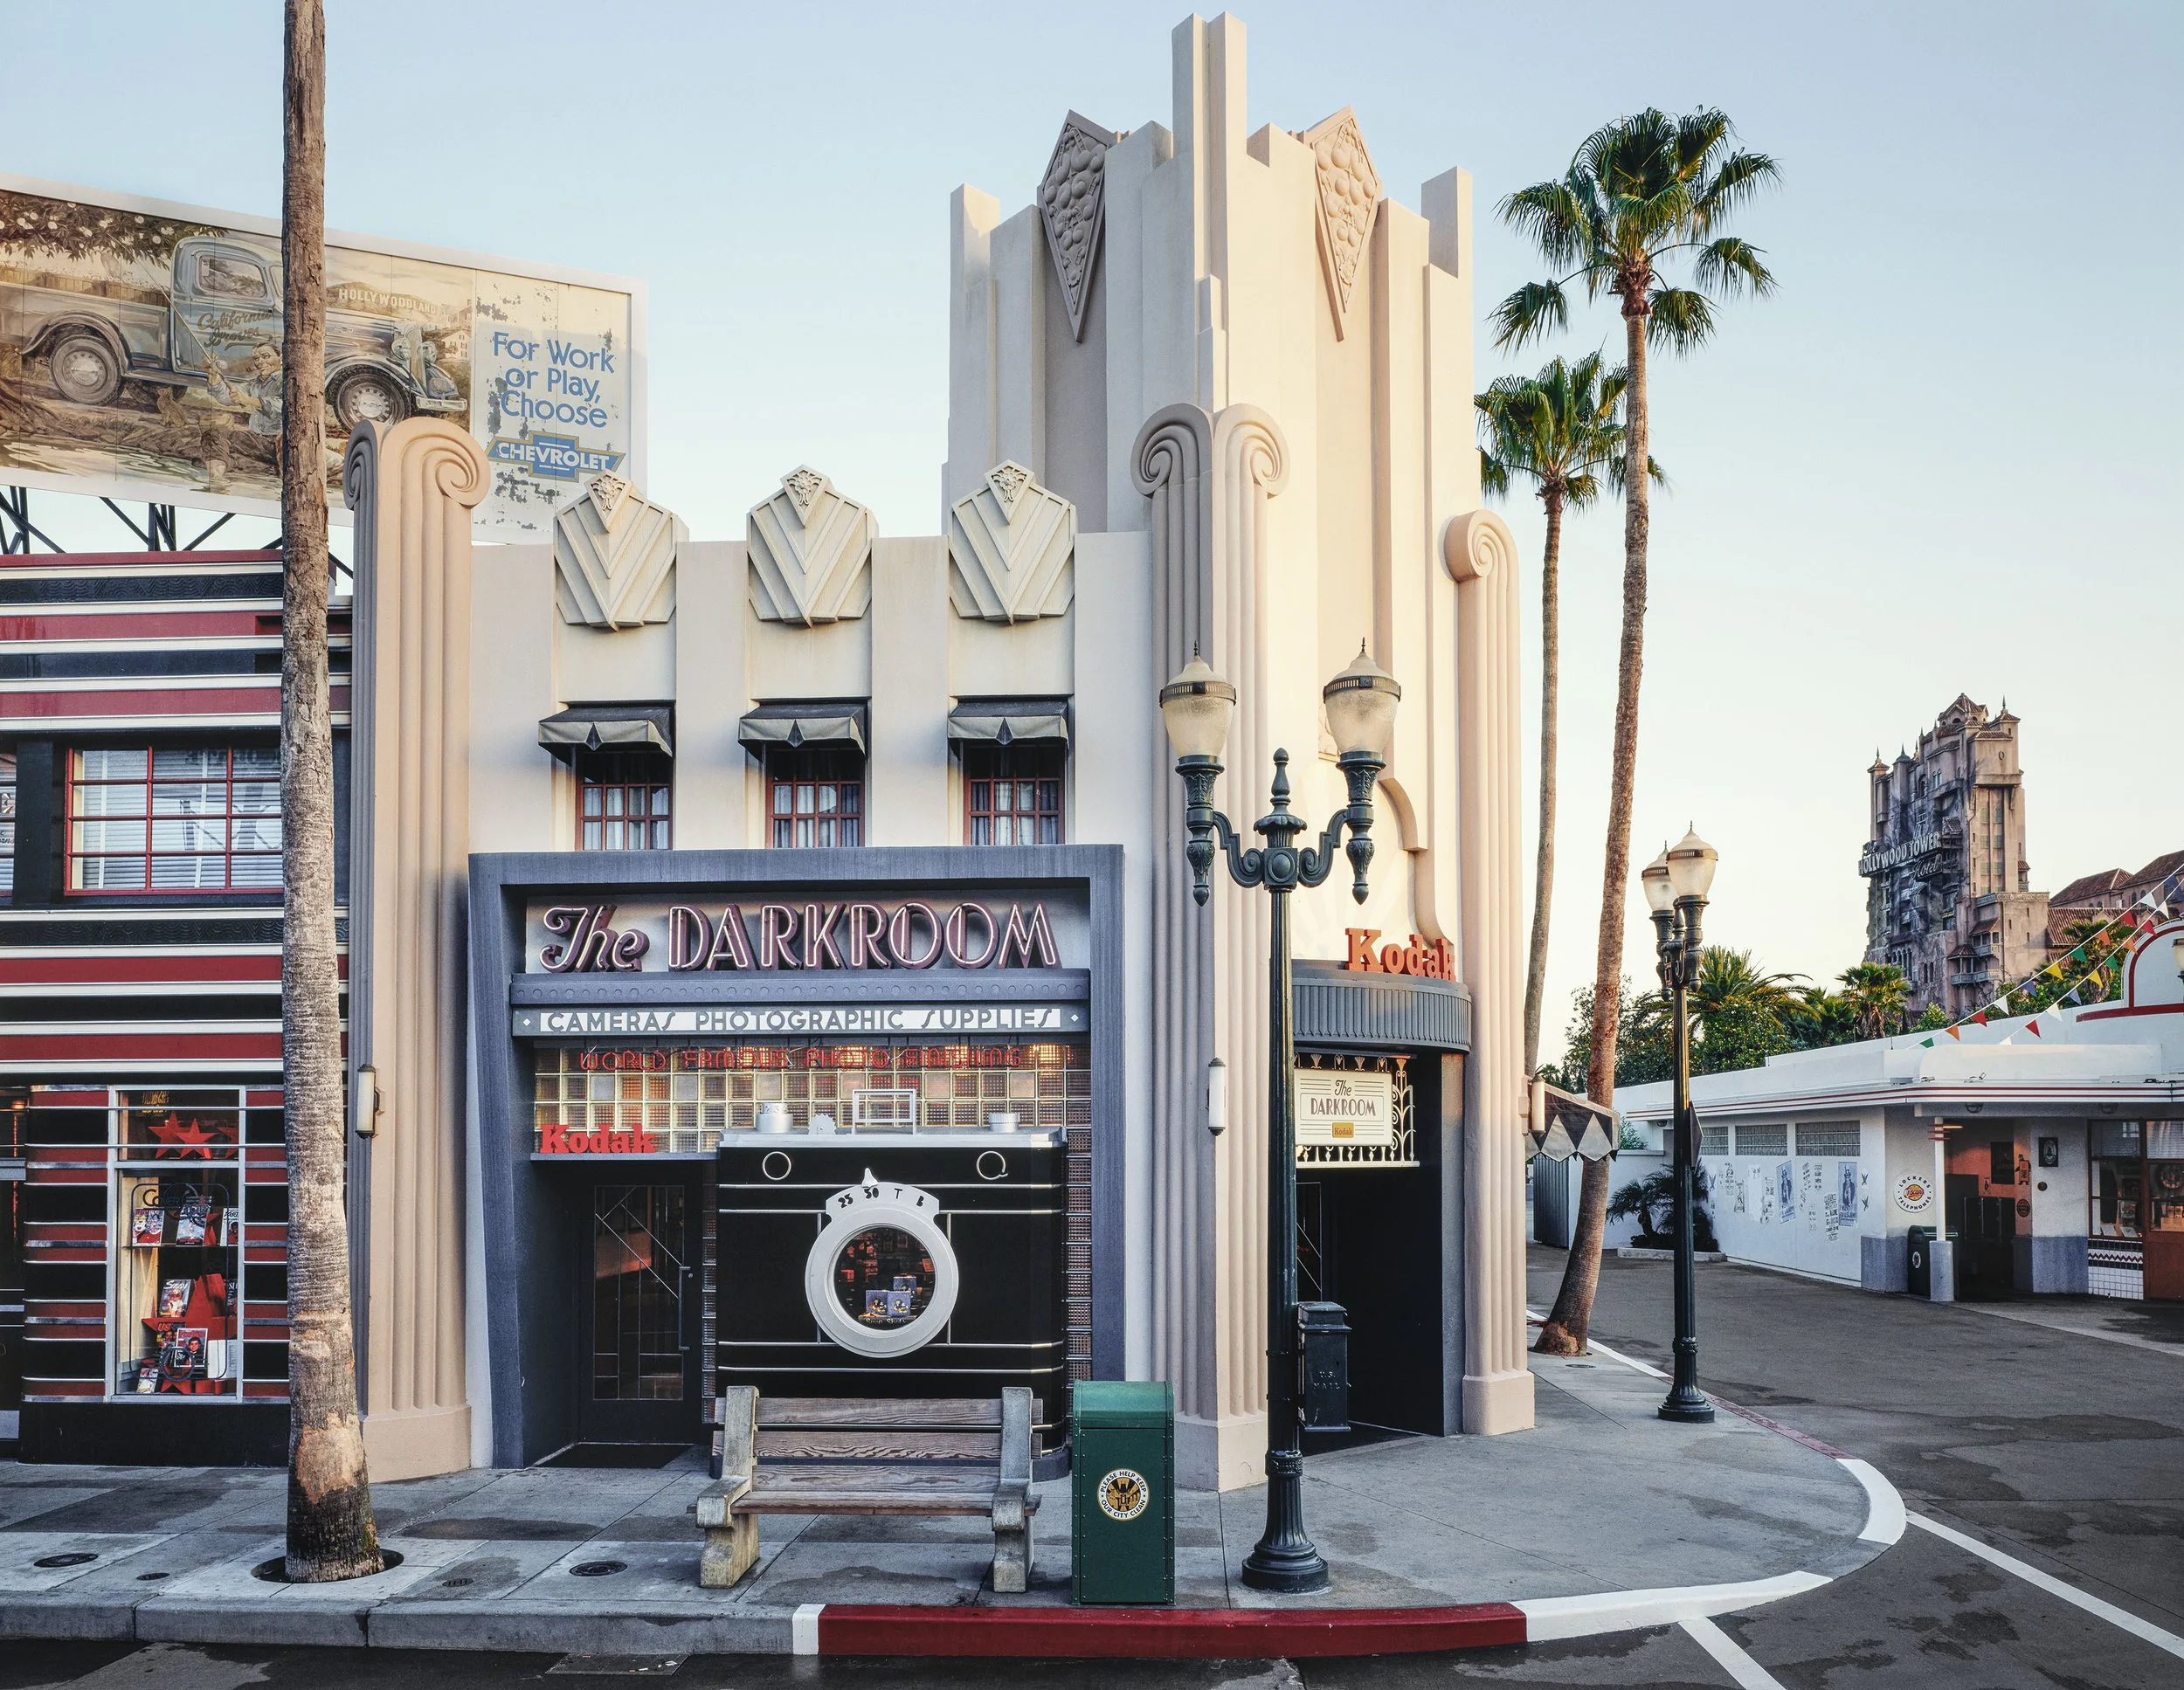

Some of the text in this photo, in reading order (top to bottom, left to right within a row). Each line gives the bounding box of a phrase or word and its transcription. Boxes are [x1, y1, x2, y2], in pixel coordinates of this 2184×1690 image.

[338, 286, 437, 314] HOLLYWOODLAND
[197, 310, 273, 331] California
[493, 331, 615, 373] For Work
[505, 367, 601, 404] or Play,
[501, 390, 608, 428] Choose
[497, 442, 610, 471] CHEVROLET
[1858, 831, 1941, 875] HOLLYWOOD TOWER
[1911, 854, 1942, 880] Hotel
[539, 902, 1063, 972] The DARKROOM
[1345, 928, 1456, 982] Kodak
[547, 1008, 1052, 1031] CAMERAS PHOTOGRAPHIC SUPPLIES
[579, 1047, 1021, 1071] WORLD FAMOUS PHOTO FINISHING
[1334, 1080, 1352, 1096] The
[1310, 1098, 1376, 1116] DARKROOM
[539, 1124, 656, 1154] Kodak
[1334, 1127, 1353, 1135] Kodak
[1898, 1176, 1931, 1189] LOCKERS
[894, 1188, 903, 1199] T
[916, 1195, 924, 1207] B
[1898, 1197, 1932, 1211] TELEPHONES
[1101, 1472, 1117, 1493] PLEASE
[1136, 1477, 1147, 1493] KEEP
[1101, 1500, 1113, 1514] OUR
[1130, 1499, 1146, 1516] CLEAN
